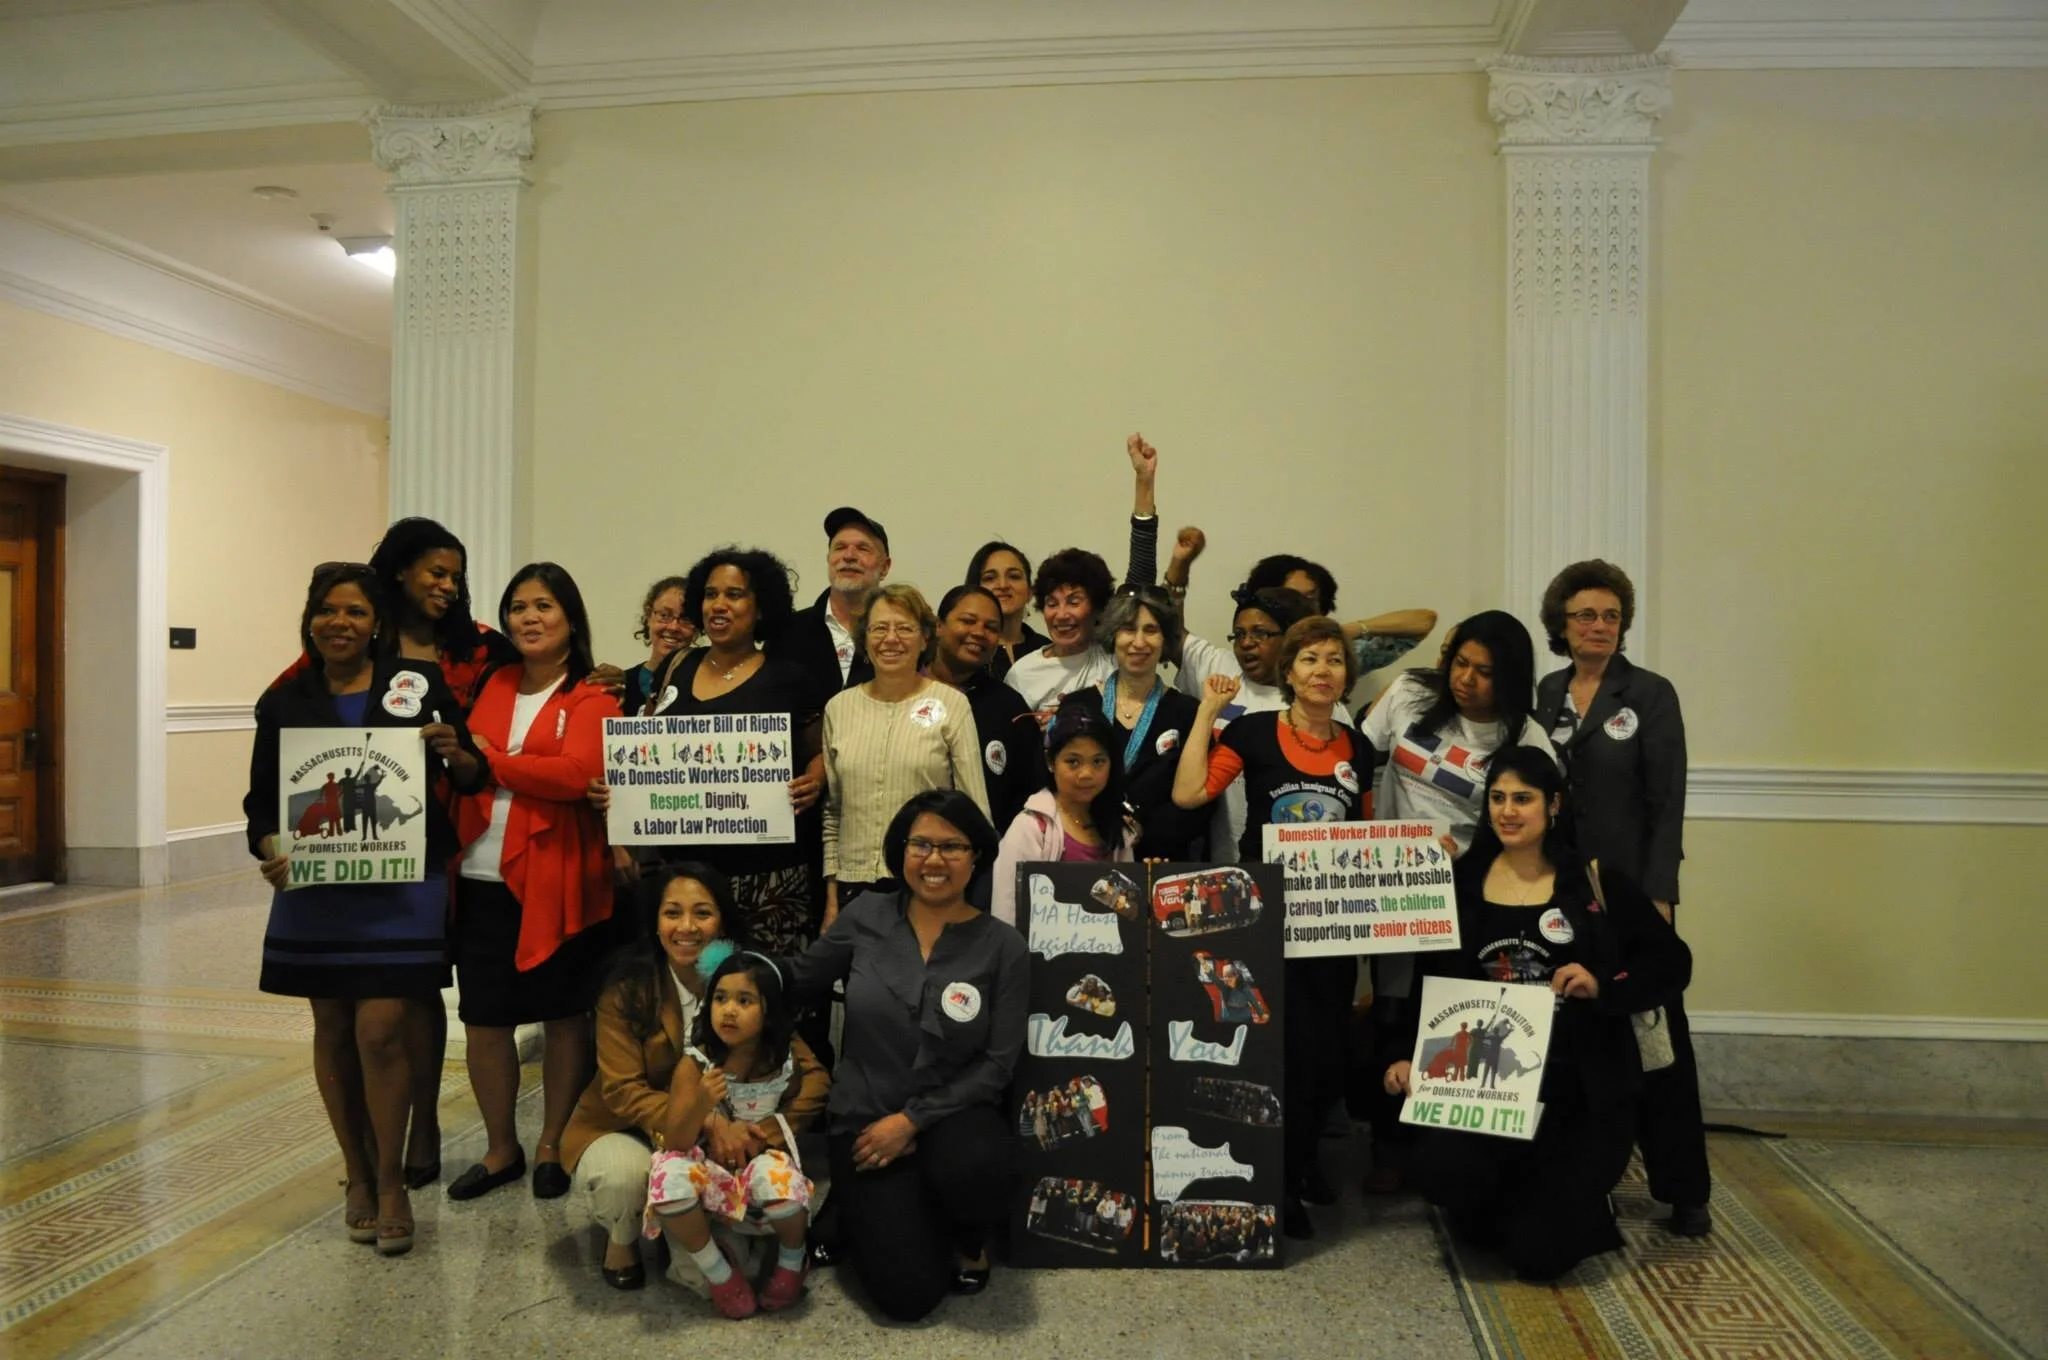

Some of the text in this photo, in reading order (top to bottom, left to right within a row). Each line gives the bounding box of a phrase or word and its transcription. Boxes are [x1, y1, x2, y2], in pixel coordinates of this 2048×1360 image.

[607, 715, 787, 736] Domestic Worker Bill of Rights
[290, 747, 410, 784] MASSACHUSETTS COALITION
[607, 766, 790, 785] We Domestic Workers Deserve
[705, 792, 749, 811] Dignity,
[633, 817, 767, 835] & Labor Law Protection
[1279, 824, 1433, 842] Domestic Worker Bill of Rights
[291, 841, 406, 853] for DOMESTIC WORKERS
[291, 858, 416, 882] WE DID IT!!
[1284, 868, 1451, 892] make all the other work possible
[1031, 904, 1117, 925] MA House
[1289, 894, 1446, 917] caring for homes, the children
[1294, 922, 1349, 943] supporting
[1354, 924, 1371, 938] our
[1373, 920, 1407, 937] senior
[1410, 919, 1452, 936] citizens
[1428, 999, 1536, 1038] MASSACHUSETTS COALITION
[1029, 1015, 1131, 1055] Thank
[1416, 1084, 1519, 1102] for DOMESTIC WORKERS
[1412, 1100, 1526, 1133] WE DID IT!!
